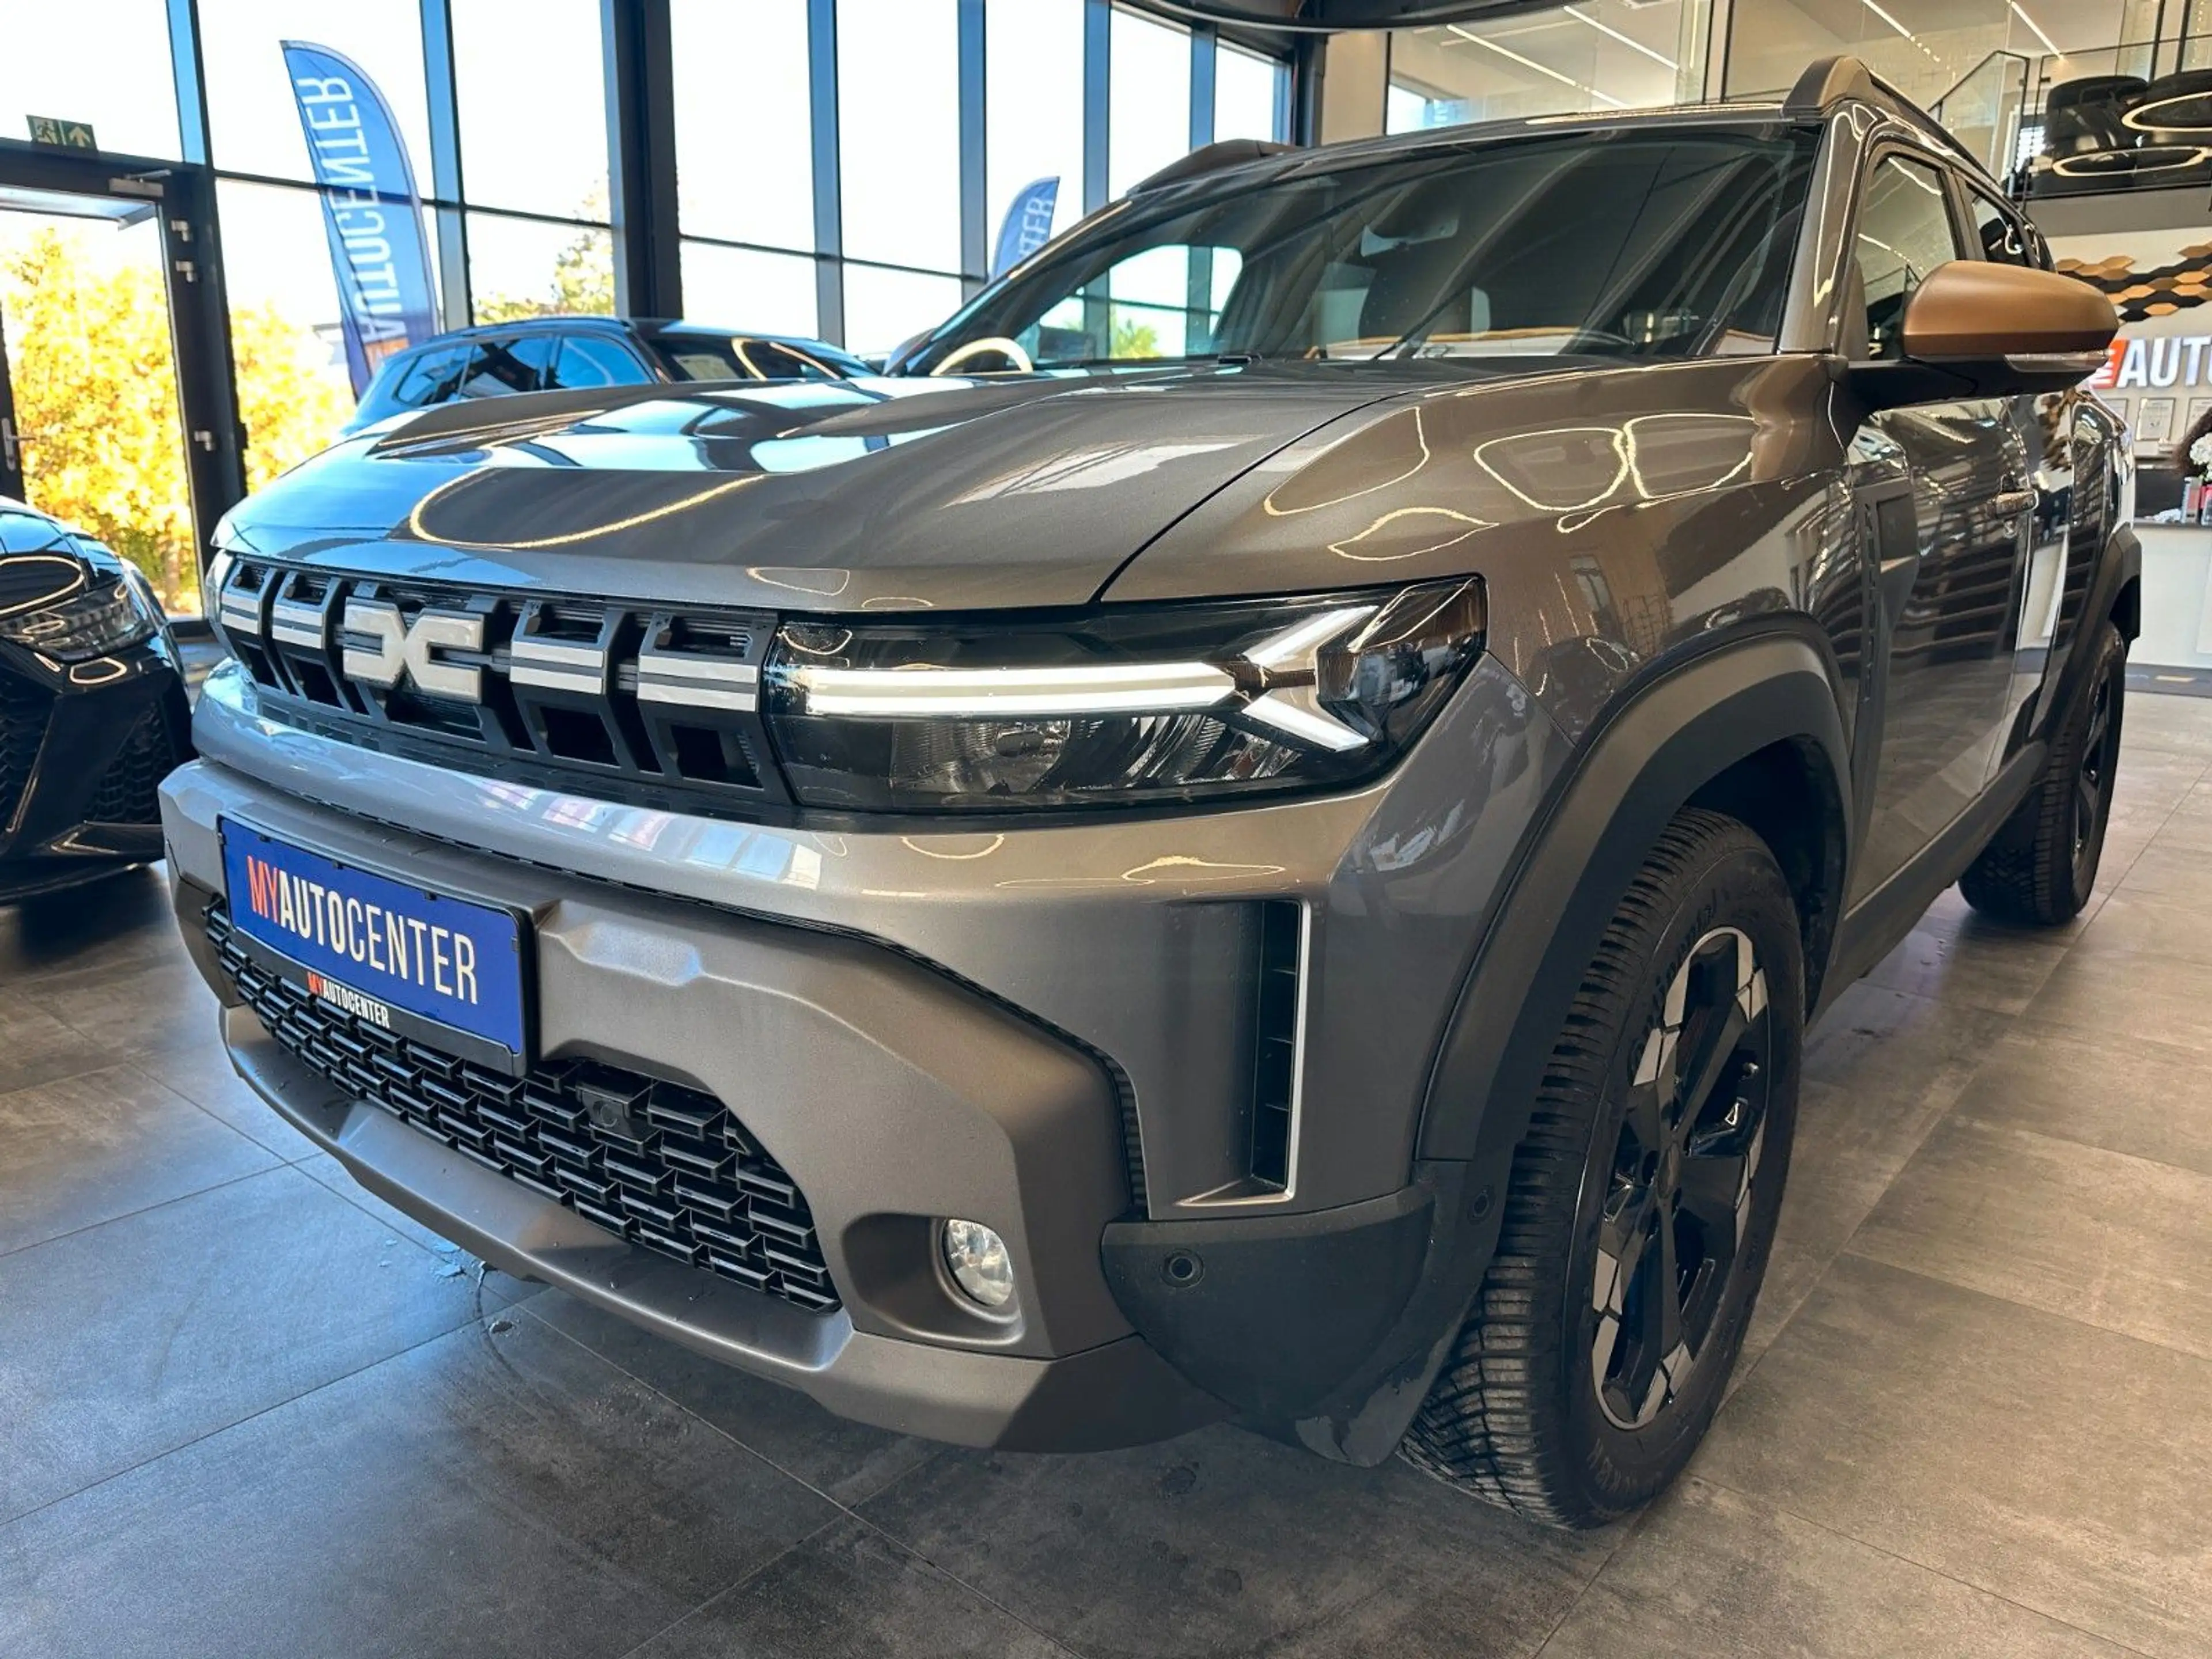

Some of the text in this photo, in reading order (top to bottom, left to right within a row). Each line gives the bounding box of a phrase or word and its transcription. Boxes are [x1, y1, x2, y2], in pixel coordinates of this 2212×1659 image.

[2116, 336, 2212, 388] AUT
[247, 855, 479, 1005] MYAUTOCENTER
[306, 971, 391, 1029] MYAUTOCENTER
